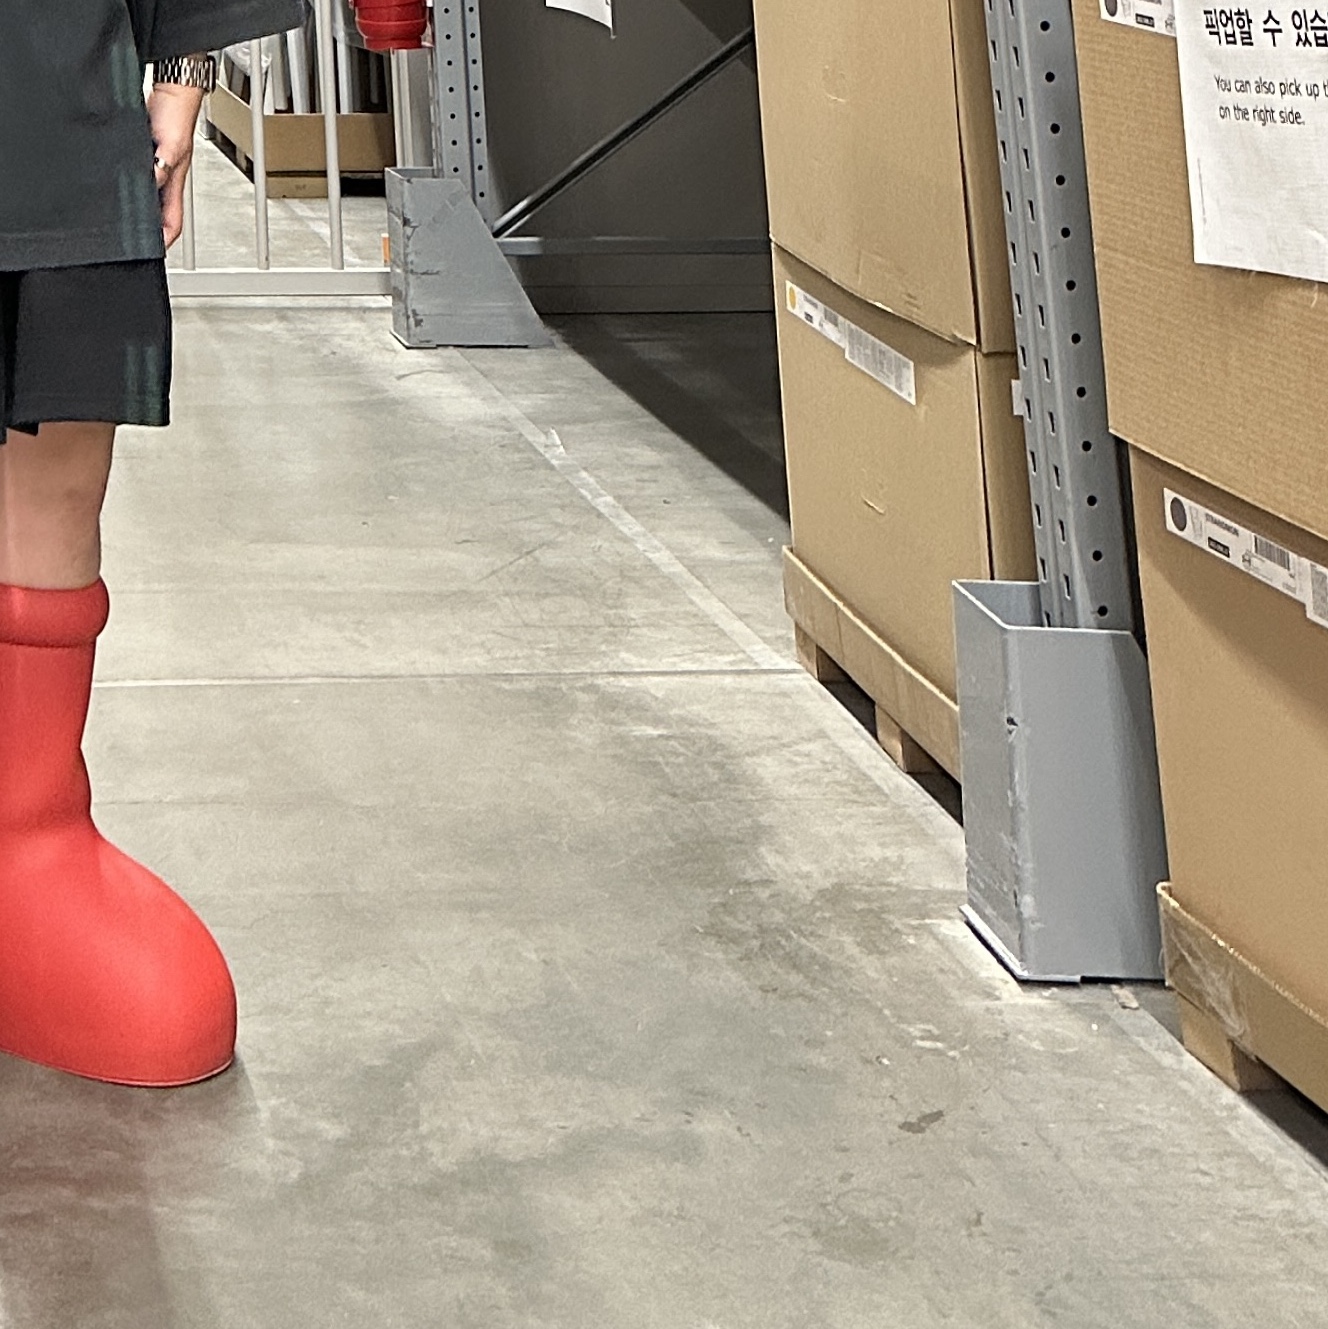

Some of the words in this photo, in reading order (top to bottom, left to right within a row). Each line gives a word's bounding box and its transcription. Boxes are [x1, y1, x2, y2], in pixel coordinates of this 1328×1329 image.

[1203, 7, 1254, 47] 픽업할
[1262, 9, 1283, 48] 수
[1291, 8, 1328, 48] 있습
[1213, 74, 1232, 93] You
[1234, 78, 1251, 94] can
[1254, 76, 1276, 95] also
[1279, 77, 1303, 99] pick
[1305, 82, 1320, 101] up
[1322, 79, 1328, 98] t
[1219, 105, 1230, 120] on
[1232, 103, 1250, 121] the
[1252, 105, 1277, 127] right
[1278, 108, 1306, 126] side.
